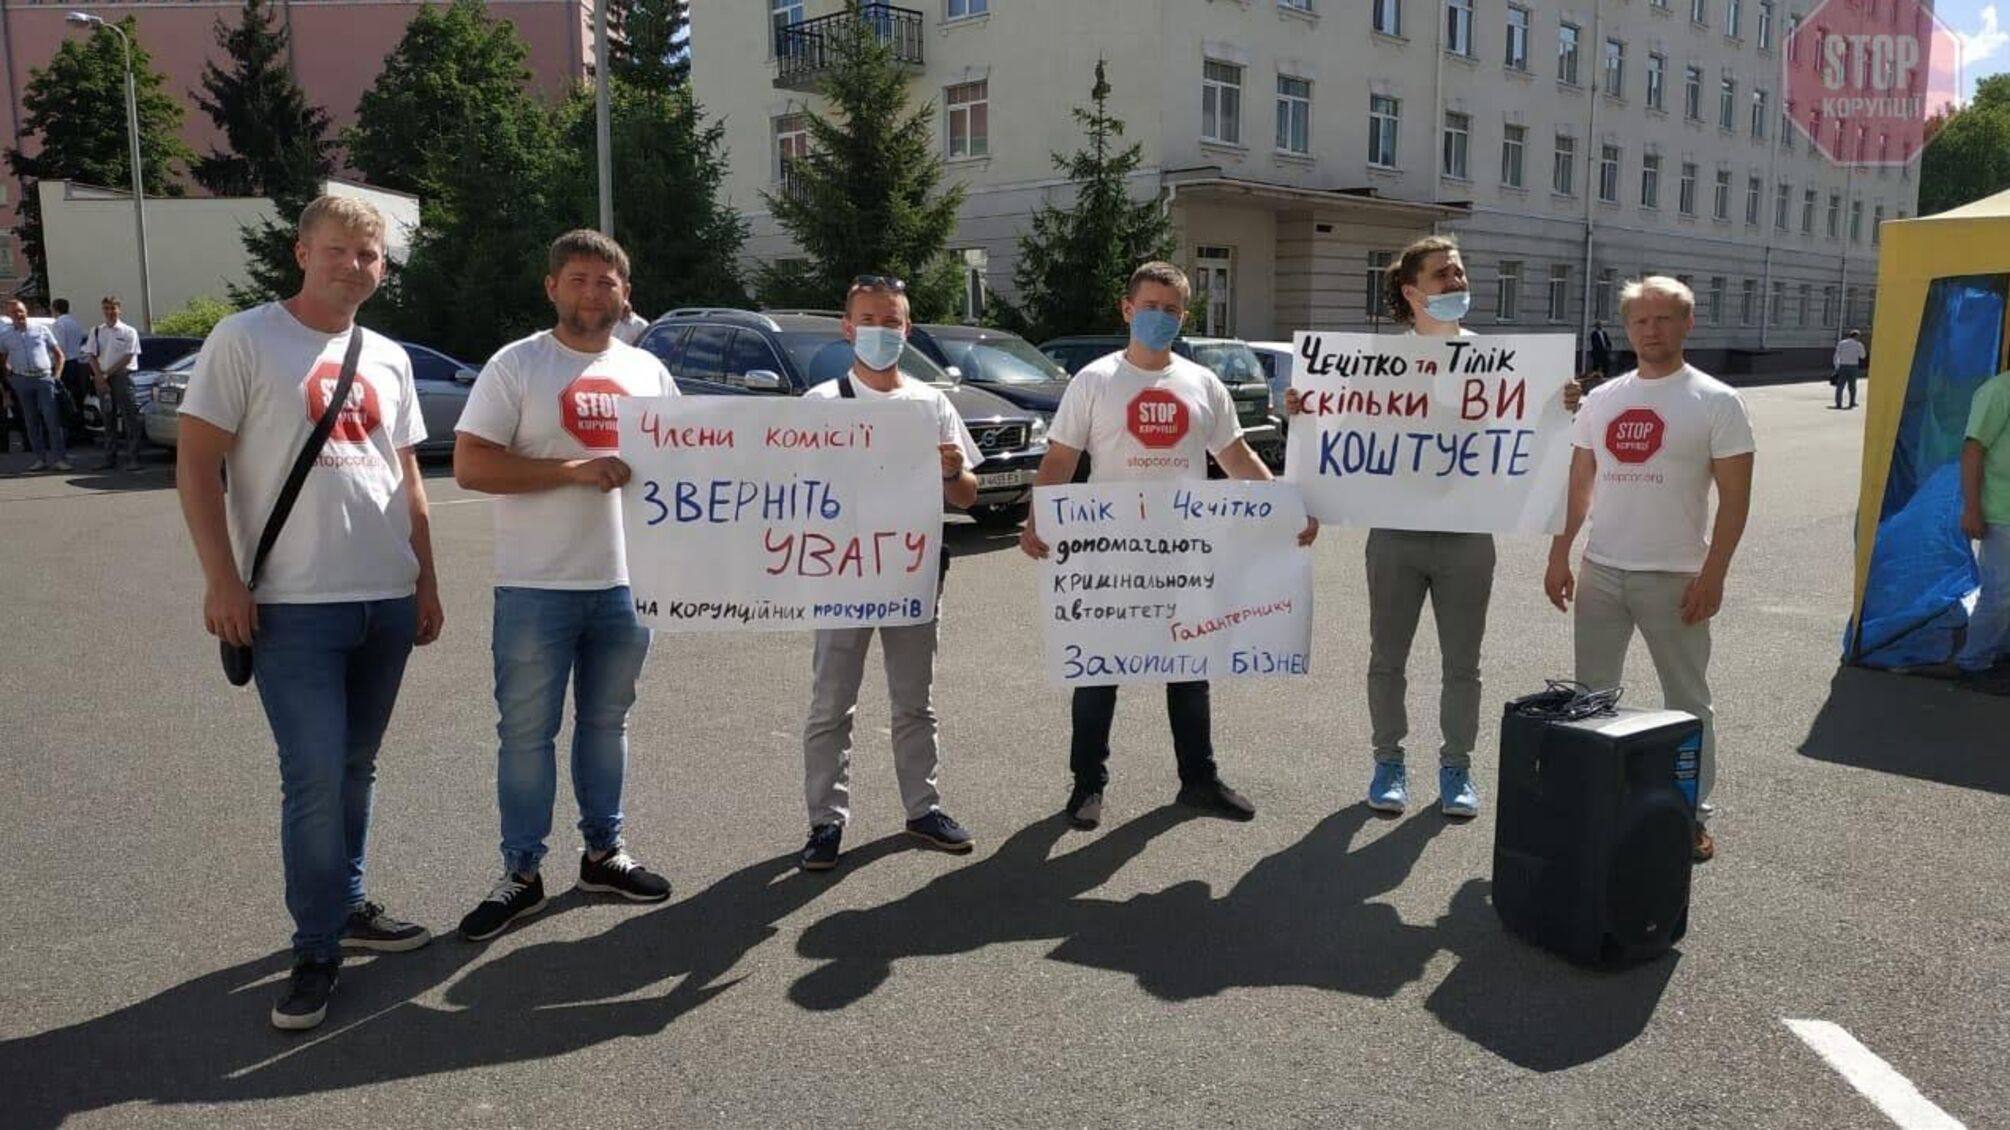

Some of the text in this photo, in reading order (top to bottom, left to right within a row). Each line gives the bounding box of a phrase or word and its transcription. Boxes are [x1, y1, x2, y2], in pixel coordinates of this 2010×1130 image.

[1138, 402, 1178, 423] STOP
[1461, 377, 1526, 420] ВИ
[1616, 422, 1654, 440] STOP
[1319, 429, 1535, 477] КОШТУЄТЕ
[644, 472, 841, 525] ЗВЕРНІТЬ
[764, 527, 926, 577] УВАГУ
[1065, 644, 1208, 679] Захопити
